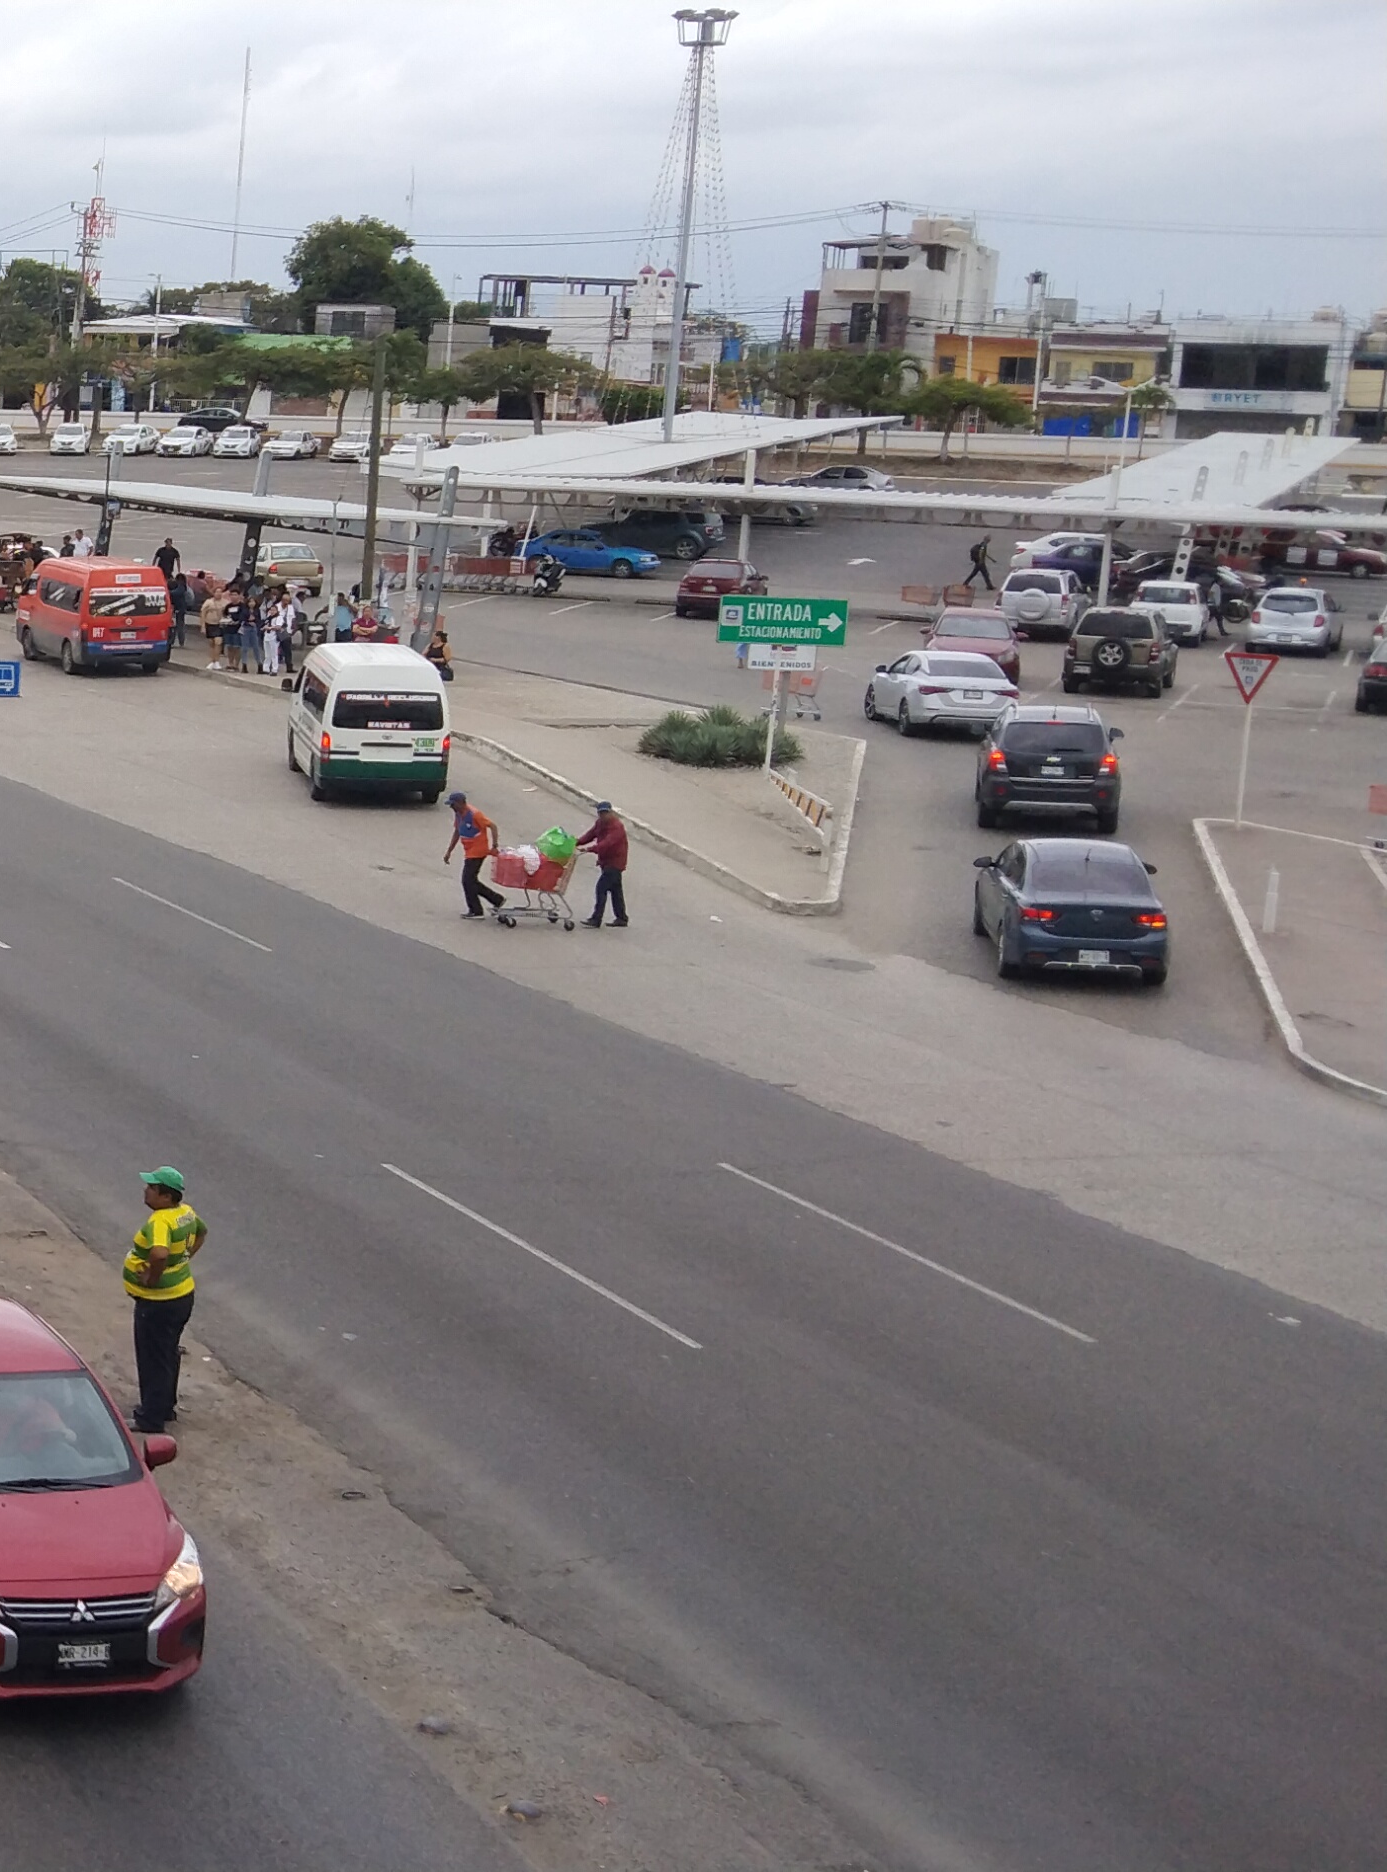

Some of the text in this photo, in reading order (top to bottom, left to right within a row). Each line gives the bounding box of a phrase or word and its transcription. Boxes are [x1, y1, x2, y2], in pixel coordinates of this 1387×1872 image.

[747, 602, 812, 621] ENTRADA
[738, 625, 823, 640] ESTACIONAMIENTO
[751, 660, 812, 668] BIENENIDOS
